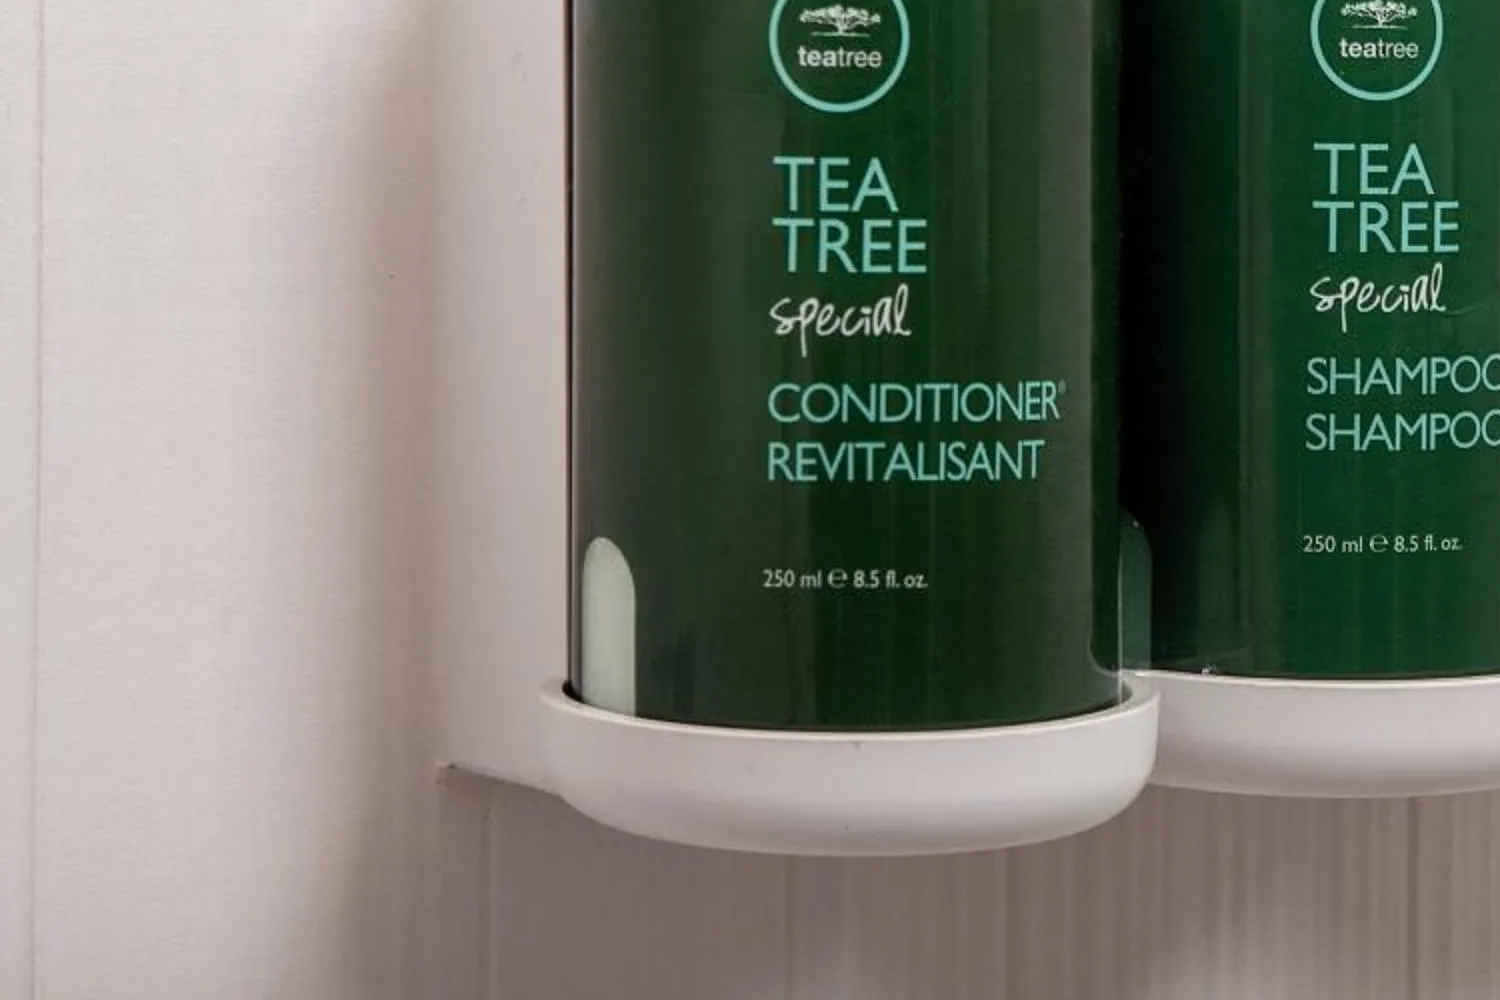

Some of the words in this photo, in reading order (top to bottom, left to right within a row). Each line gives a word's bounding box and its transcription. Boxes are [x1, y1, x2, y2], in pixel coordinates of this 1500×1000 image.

[797, 45, 882, 68] teatree
[1339, 37, 1419, 60] teatree
[772, 155, 899, 212] TEA
[1313, 142, 1435, 196] TEA
[772, 217, 928, 274] TREE
[1312, 200, 1460, 254] TREE
[769, 283, 912, 358] special
[1309, 261, 1447, 333] special
[767, 439, 1046, 482] REVITALISANT
[1302, 535, 1337, 553] 250
[1341, 535, 1364, 553] ml
[1393, 534, 1420, 553] 8.5
[1423, 534, 1438, 552] fl.
[763, 568, 796, 589] 250
[800, 569, 823, 589] ml
[853, 568, 881, 589] 8.5
[885, 569, 900, 589] fl.
